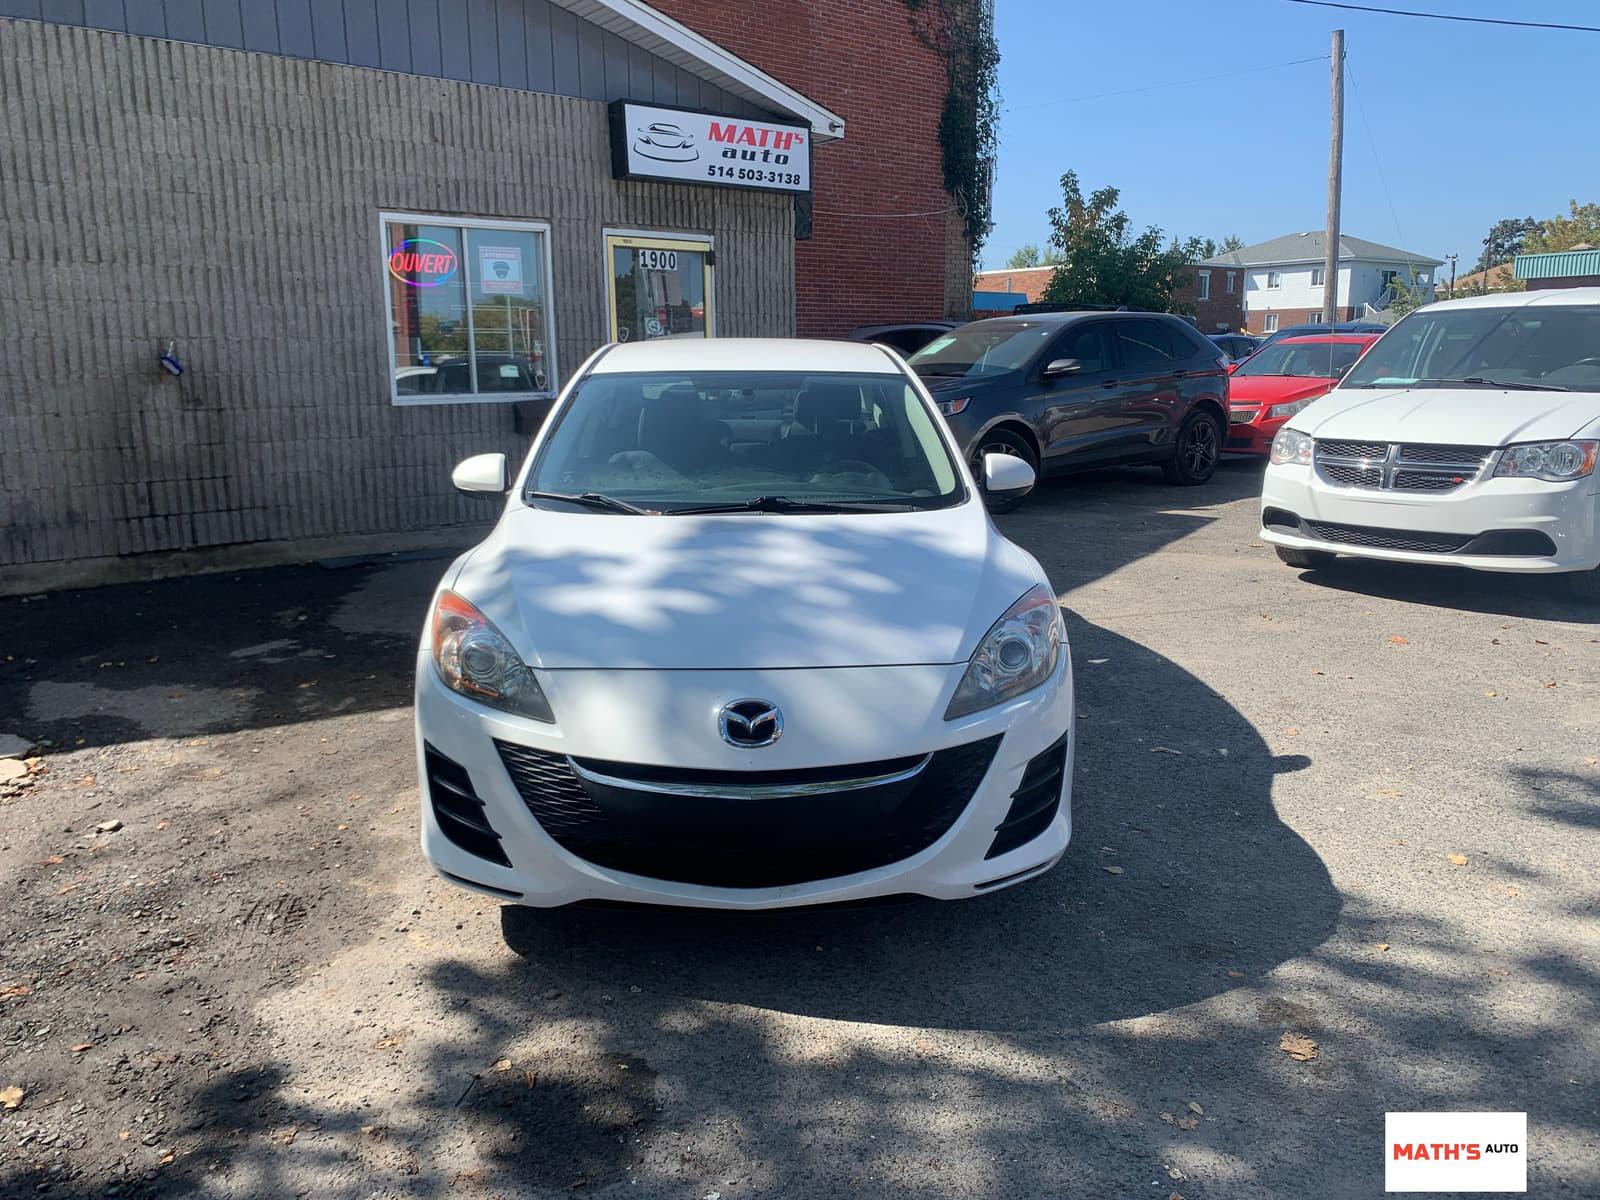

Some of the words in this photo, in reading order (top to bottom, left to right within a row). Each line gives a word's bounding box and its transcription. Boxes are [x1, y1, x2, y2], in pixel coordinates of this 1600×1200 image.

[721, 147, 789, 165] auto
[707, 165, 735, 179] 514
[738, 169, 801, 185] 503-3138
[391, 252, 452, 274] OUVERT
[640, 250, 676, 269] 1900
